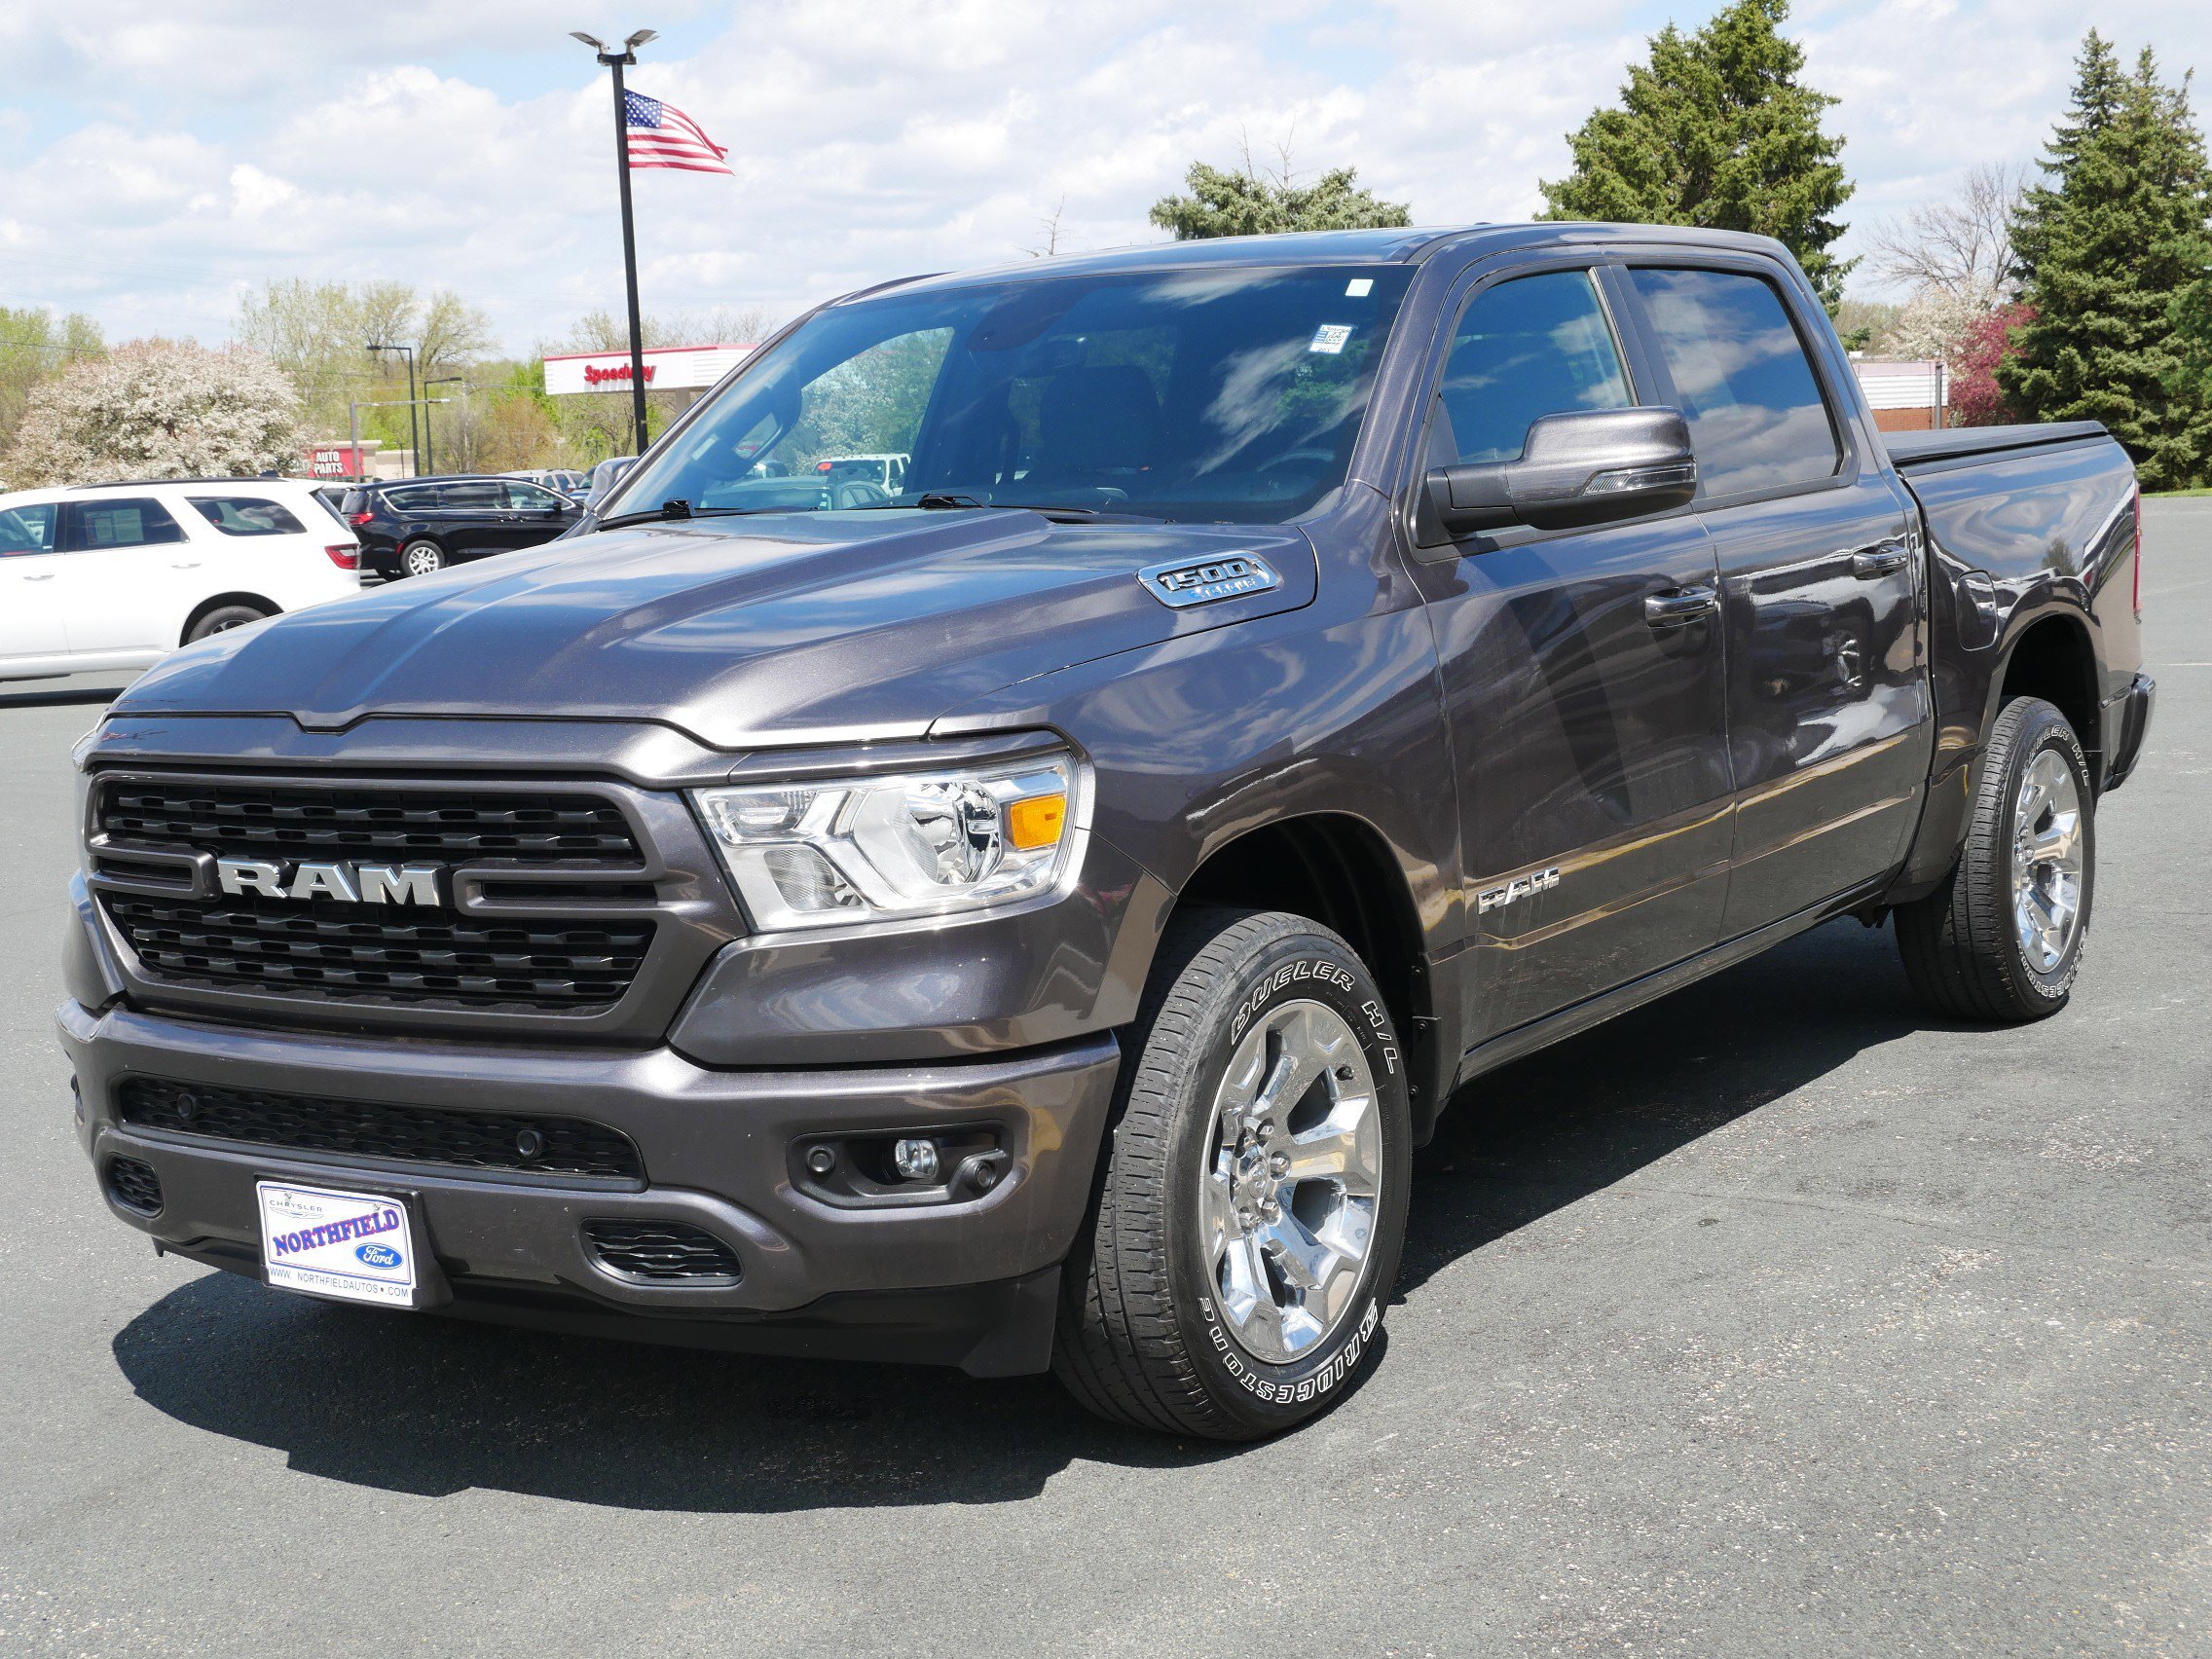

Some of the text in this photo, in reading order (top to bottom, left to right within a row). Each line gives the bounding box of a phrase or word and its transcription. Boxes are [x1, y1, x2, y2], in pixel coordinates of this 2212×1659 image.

[314, 462, 343, 474] PARTS
[315, 451, 340, 462] AUTO
[1158, 559, 1251, 591] 1500
[217, 859, 441, 906] RAM
[1477, 866, 1560, 914] RAM
[1231, 961, 1357, 1046] DUELER
[269, 1199, 323, 1212] CHRYSLER
[273, 1209, 400, 1256] NORTHFIELD
[363, 1245, 393, 1266] Ford
[1198, 1298, 1379, 1404] BRIDGESTONE
